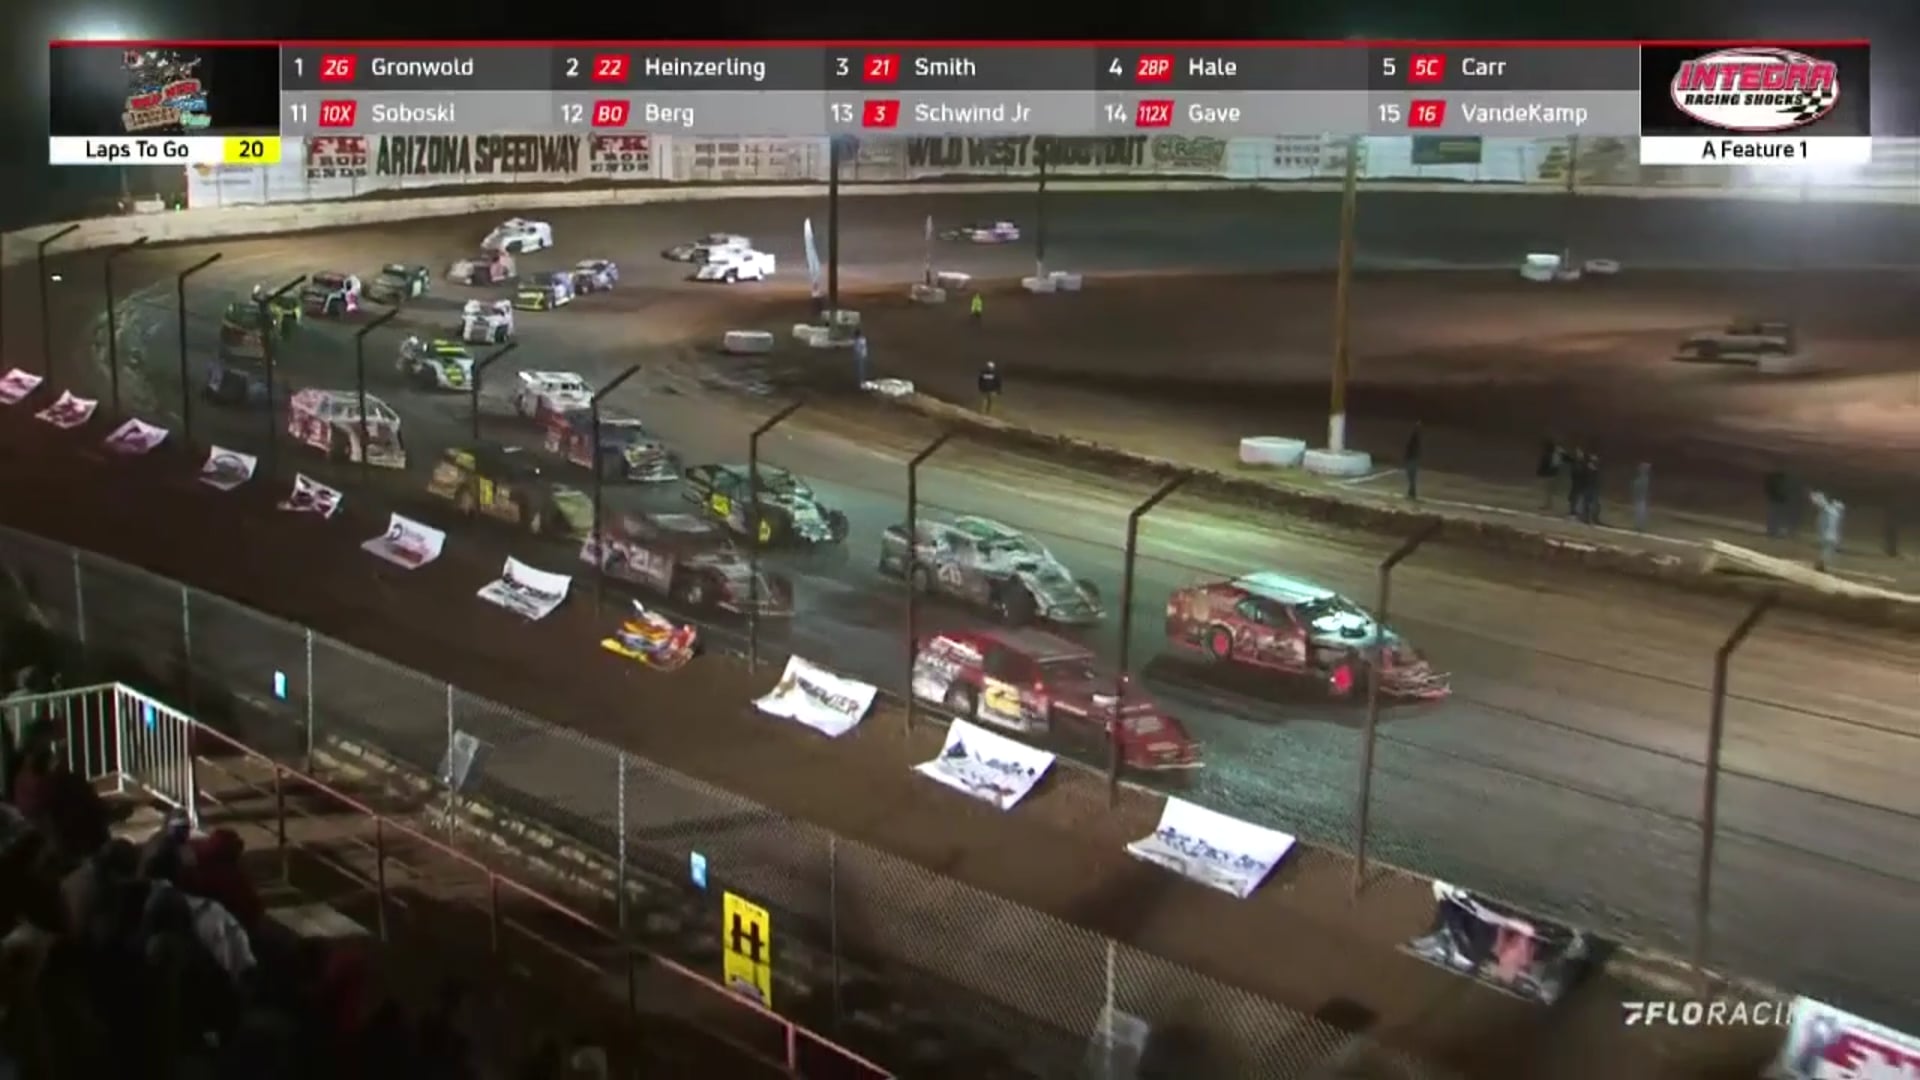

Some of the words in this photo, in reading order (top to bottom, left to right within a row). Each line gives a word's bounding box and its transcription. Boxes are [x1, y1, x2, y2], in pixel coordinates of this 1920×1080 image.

[376, 135, 470, 176] ARIZONA
[474, 135, 581, 174] SPEEDWAY
[731, 911, 765, 963] H
